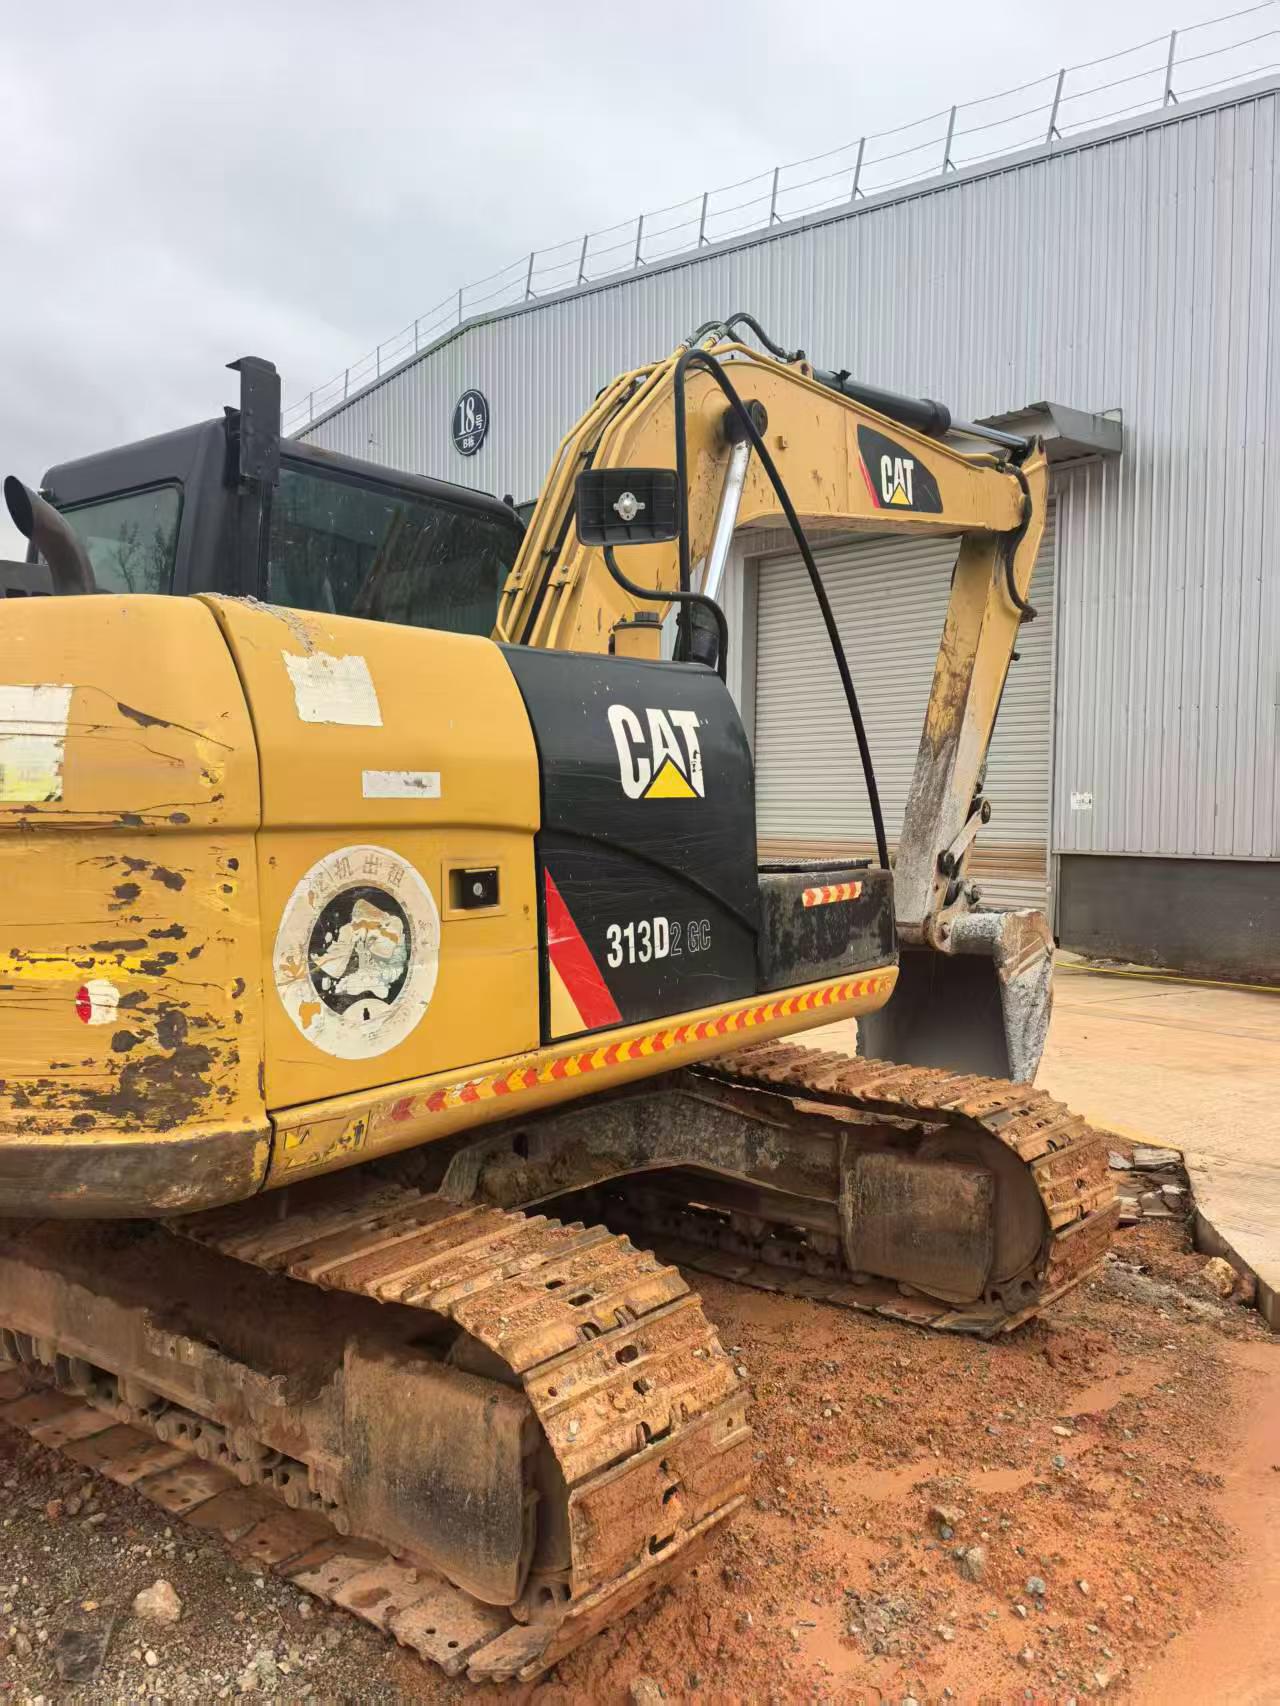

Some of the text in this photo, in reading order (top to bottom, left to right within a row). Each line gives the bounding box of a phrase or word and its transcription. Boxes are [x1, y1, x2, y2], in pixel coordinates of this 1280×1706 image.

[881, 455, 914, 505] CAT
[608, 704, 705, 799] CAT
[687, 919, 711, 952] GC
